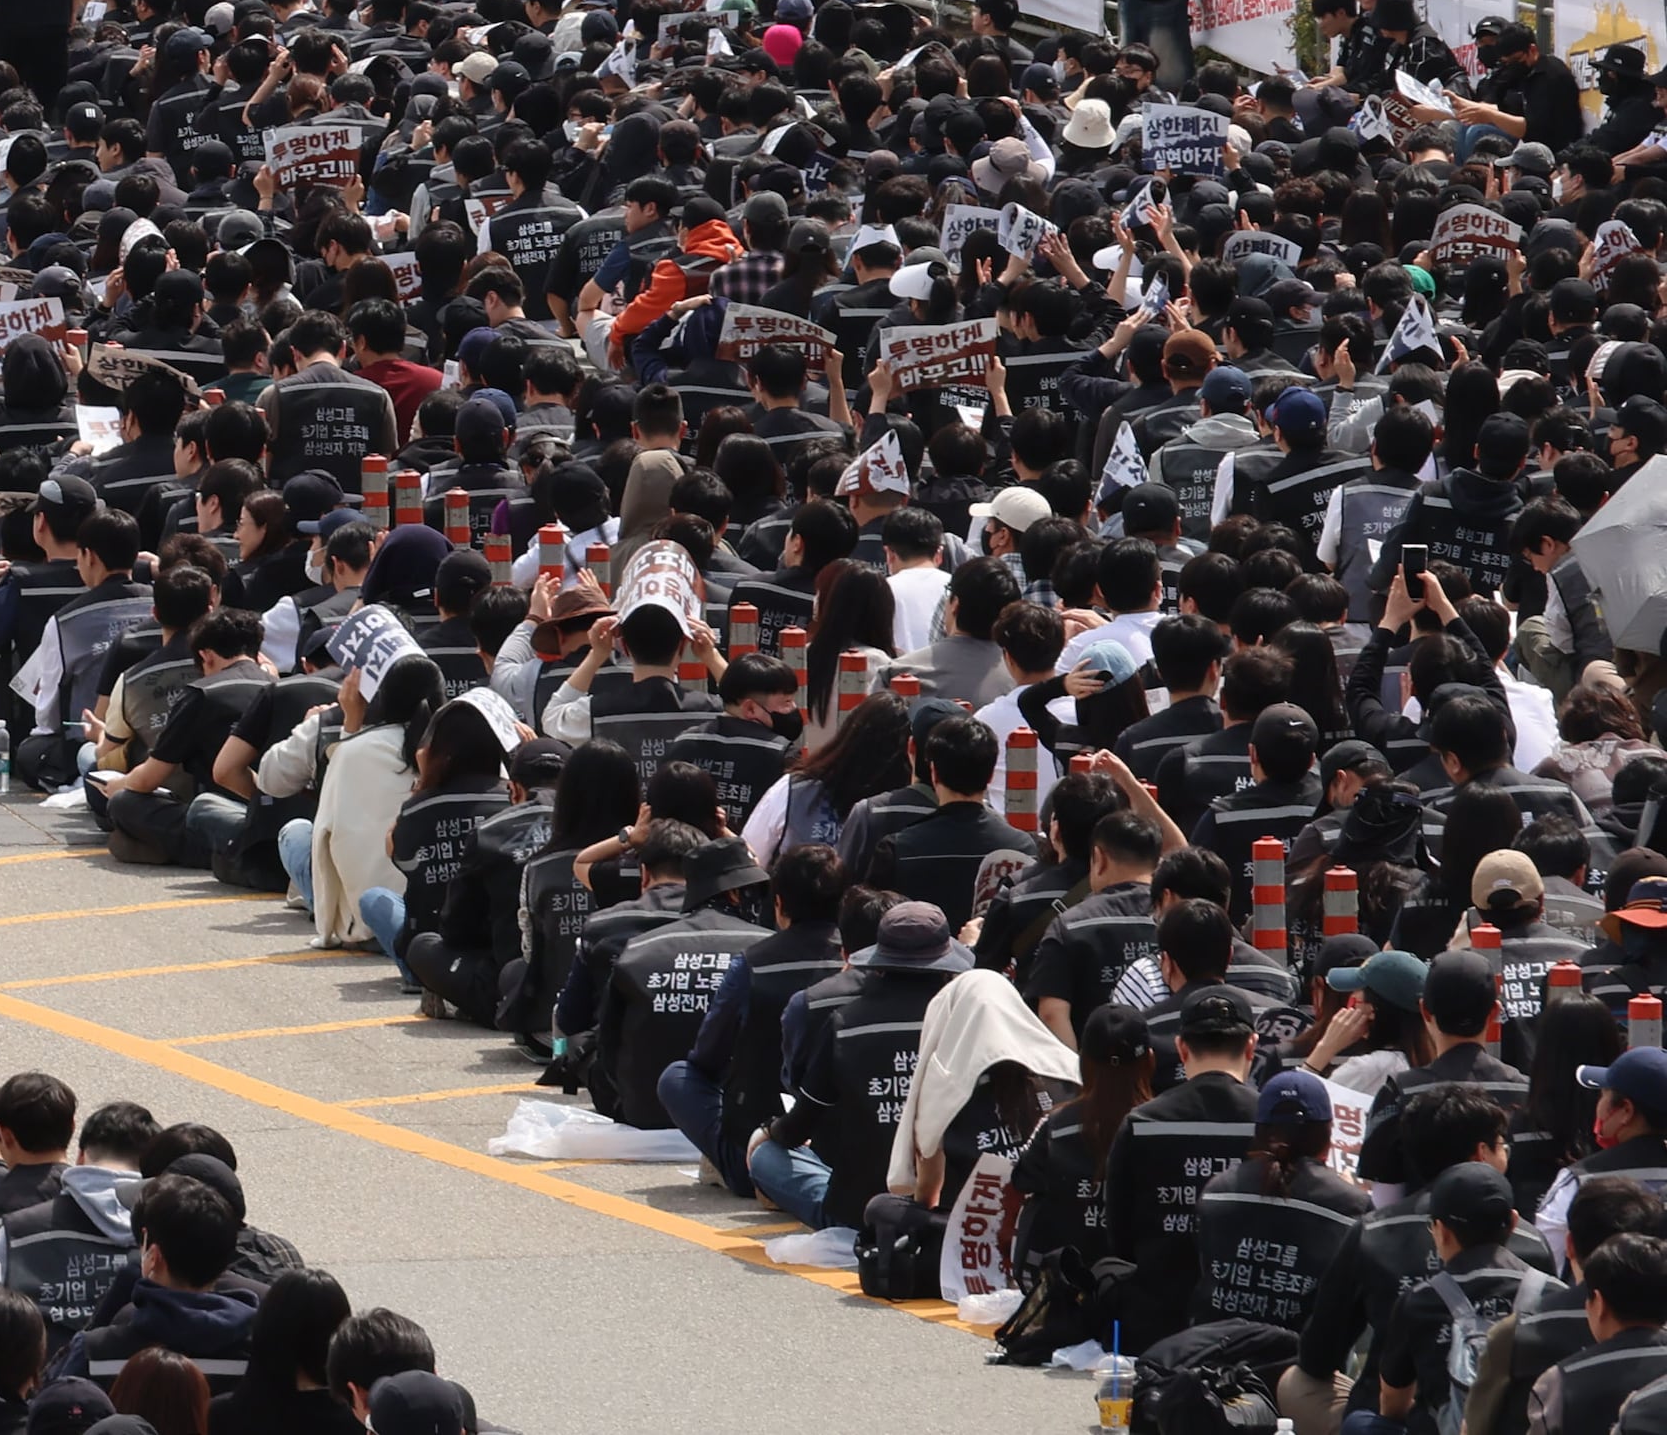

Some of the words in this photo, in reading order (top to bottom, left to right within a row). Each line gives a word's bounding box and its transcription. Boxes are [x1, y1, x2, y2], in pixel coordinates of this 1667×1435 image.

[1146, 113, 1219, 142] 상한폐지
[272, 129, 350, 162] 투명하게
[1154, 145, 1223, 167] 실현하자
[279, 160, 355, 185] 바꾸고!!!
[517, 222, 553, 235] 삼성그룹
[1436, 214, 1510, 239] 투명하게
[513, 251, 547, 265] 삼성전자
[733, 314, 829, 345] 투명하게
[888, 321, 984, 361] 투명하게
[899, 355, 989, 388] 바꾸고!!!
[316, 407, 355, 422] 삼성그룹
[304, 442, 344, 457] 삼성전자
[346, 441, 367, 456] 지부
[1455, 526, 1494, 545] 삼성그룹
[1432, 541, 1461, 559] 초기업
[1470, 548, 1511, 566] 노동조합
[1481, 569, 1503, 585] 지부
[417, 839, 452, 861] 초기업
[1157, 1186, 1196, 1205] 초기업
[959, 1171, 1002, 1294] 투명하게
[1236, 1237, 1298, 1267] 삼성그룹
[1211, 1261, 1252, 1286] 초기업
[39, 1280, 87, 1302] 초기업
[1211, 1287, 1268, 1316] 삼성전자
[1273, 1300, 1301, 1321] 지부
